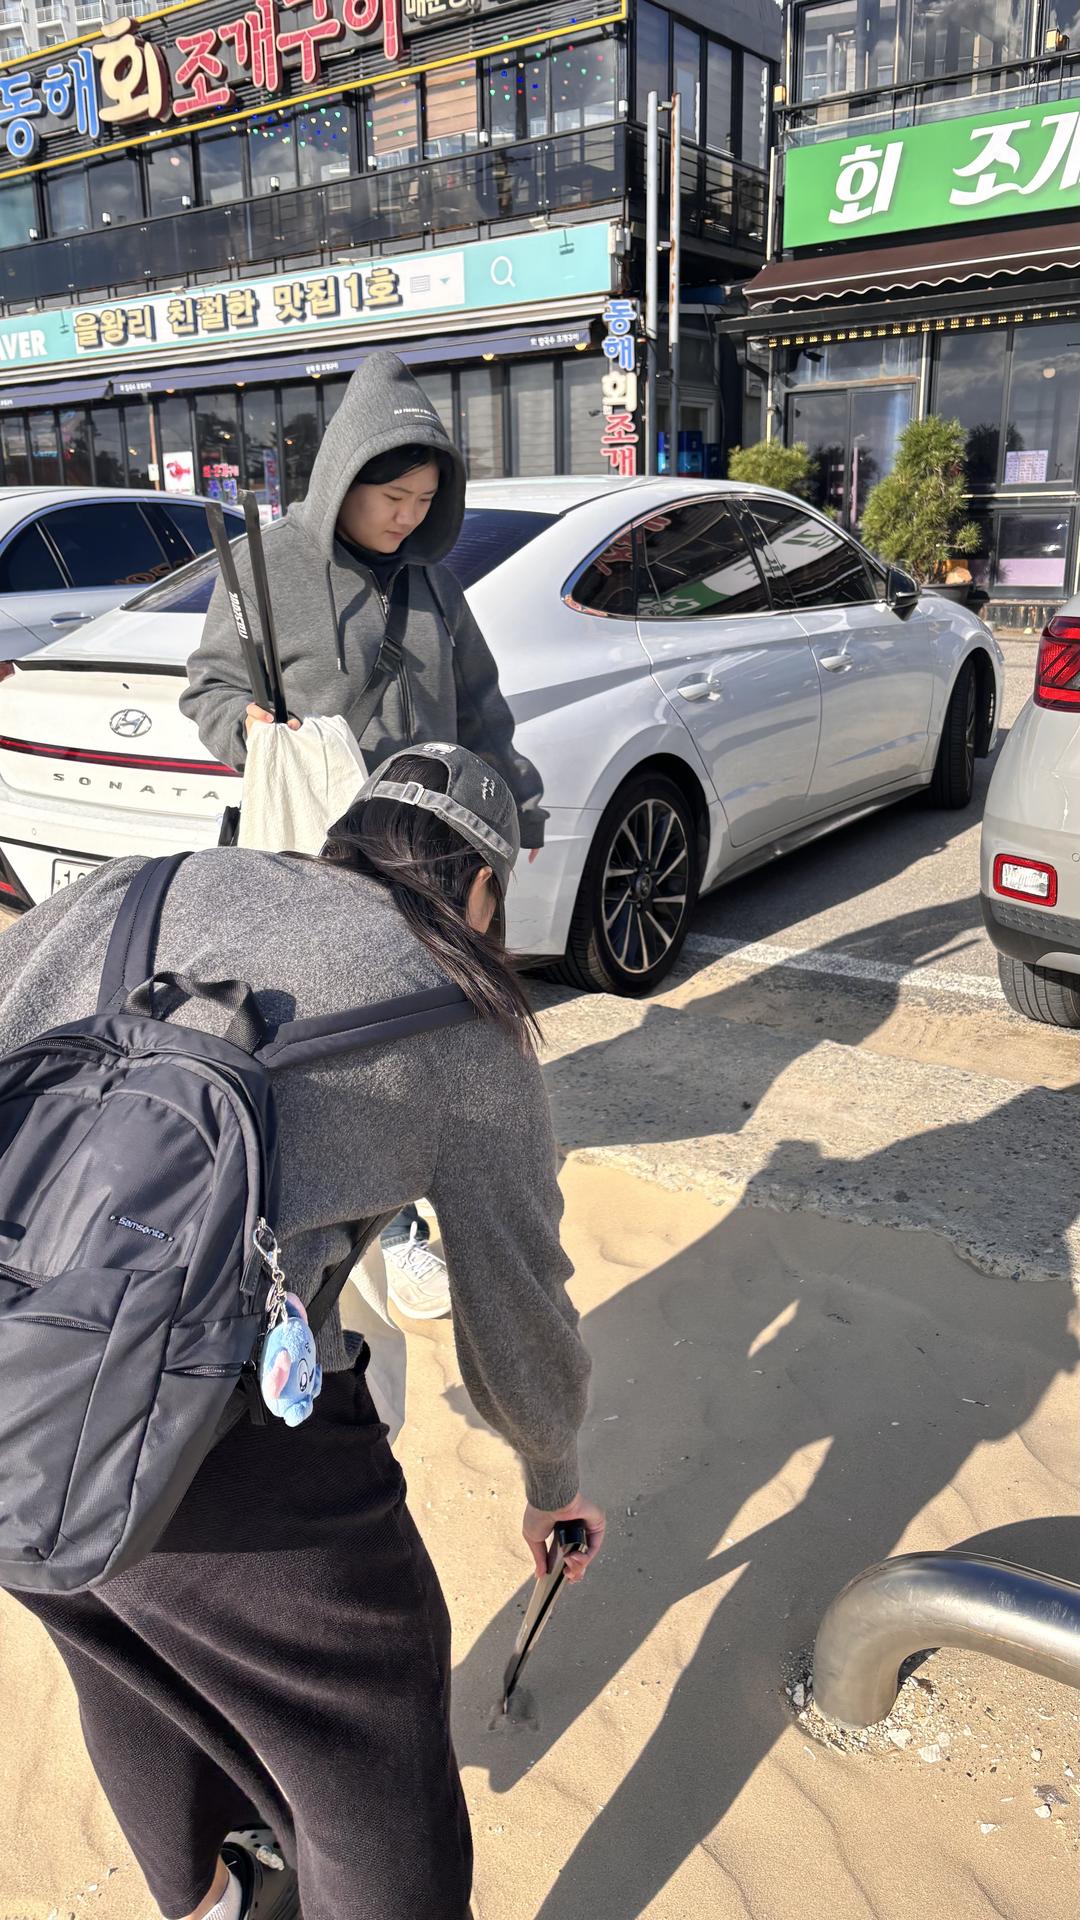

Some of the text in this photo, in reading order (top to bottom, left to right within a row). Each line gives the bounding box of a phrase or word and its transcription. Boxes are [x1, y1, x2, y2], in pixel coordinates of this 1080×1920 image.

[93, 17, 163, 122] 회
[828, 141, 904, 224] 회
[74, 305, 153, 347] 을왕리
[167, 289, 256, 334] 친절한
[602, 300, 637, 371] 동해
[602, 371, 638, 413] 회
[53, 773, 219, 800] SONATA
